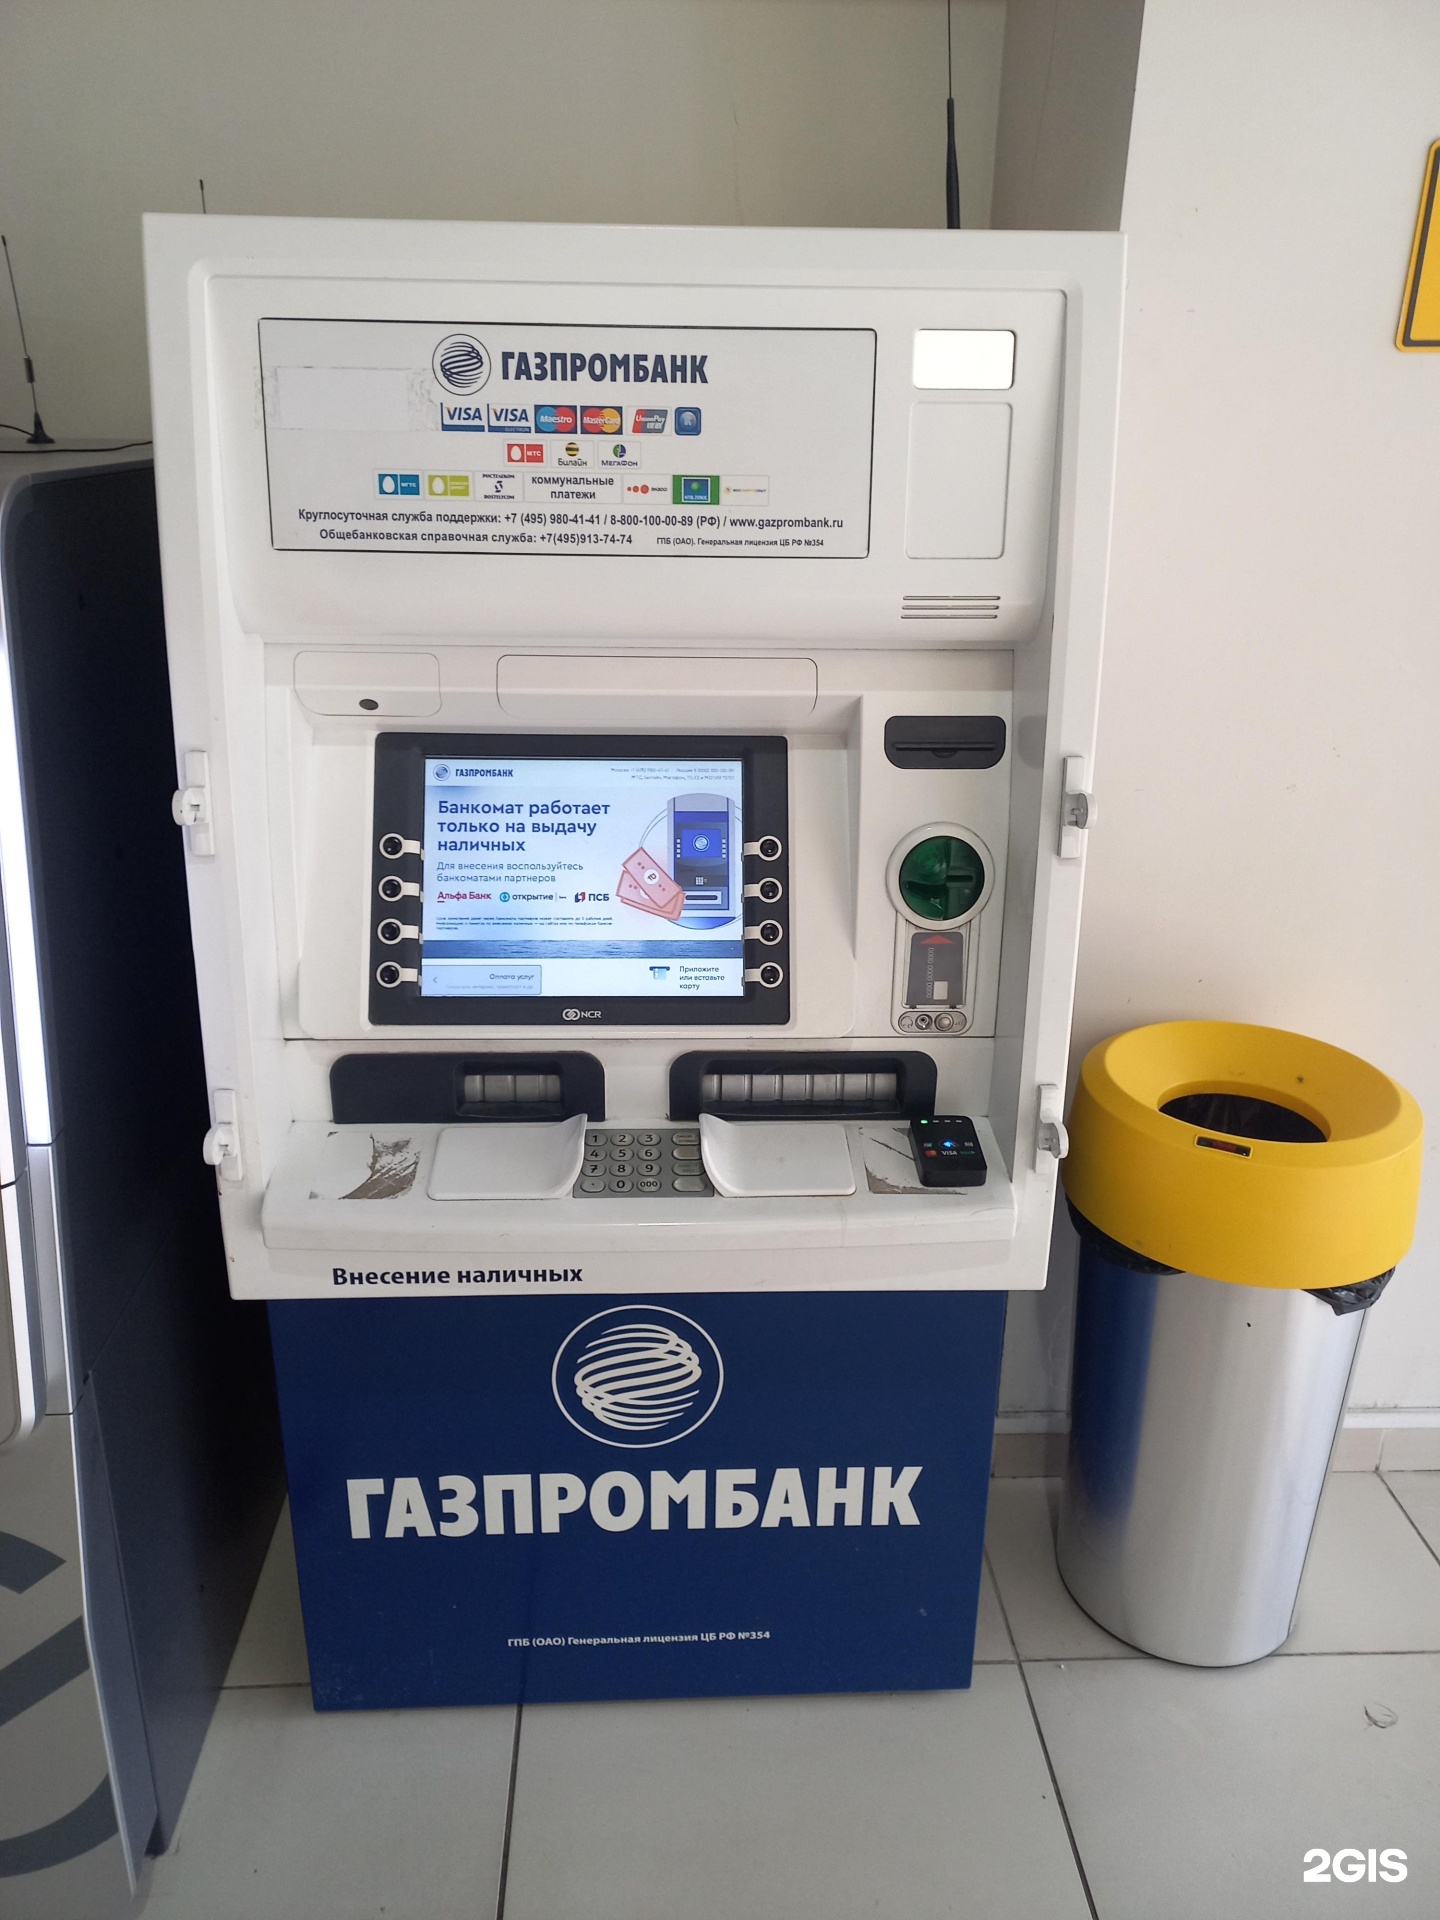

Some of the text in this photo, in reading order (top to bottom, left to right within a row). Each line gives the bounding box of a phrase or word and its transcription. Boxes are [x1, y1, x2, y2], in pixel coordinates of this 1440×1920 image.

[501, 351, 709, 384] ГАЗПРОМБАНК
[445, 406, 483, 421] VISA
[491, 407, 529, 422] VISA
[539, 414, 573, 425] Maestro
[583, 416, 621, 426] MasterCard
[557, 458, 588, 467] Билайн
[531, 476, 614, 487] коммунальные
[550, 490, 596, 500] платежи
[298, 509, 389, 525] Круглосуточная
[391, 511, 433, 524] служба
[436, 513, 502, 525] поддержки:
[504, 513, 518, 524] +7
[520, 512, 547, 526] (495)
[549, 513, 601, 525] 980-41-41
[610, 514, 693, 527] 8-800-100-00-89
[696, 515, 721, 528] (РФ)
[729, 516, 844, 531] www.gazprombank.ru
[319, 528, 633, 546] Общебанковская справочная служба: +7(495)913-74-74
[697, 538, 743, 548] Генеральная
[744, 540, 778, 548] лицензия
[779, 538, 791, 548] ЦБ
[791, 539, 803, 548] РФ
[804, 539, 824, 547] №354
[455, 768, 514, 777] ГАЗПРОМБАНК
[438, 800, 611, 817] Банкомат работает
[437, 821, 597, 836] только на выдачу
[437, 840, 526, 851] наличных
[436, 862, 584, 872] Для внесения воспользуйтесь
[436, 873, 556, 884] банкоматами партнеров
[437, 891, 492, 901] Альфа Банк
[512, 893, 554, 902] открытие
[588, 893, 610, 902] ПСБ
[679, 965, 720, 973] Приложите
[580, 1010, 602, 1019] NCR
[593, 1134, 653, 1143] 1 2 3
[590, 1149, 653, 1158] 4 5 6
[589, 1164, 653, 1173] 7 8 9
[616, 1180, 625, 1189] 0
[332, 1265, 583, 1287] Внесение наличных
[346, 1466, 923, 1540] ГАЗПРОМБАНК
[507, 1631, 771, 1648] ГПБ (ОАО) Генеральная лицензия ЦБ РФ №354
